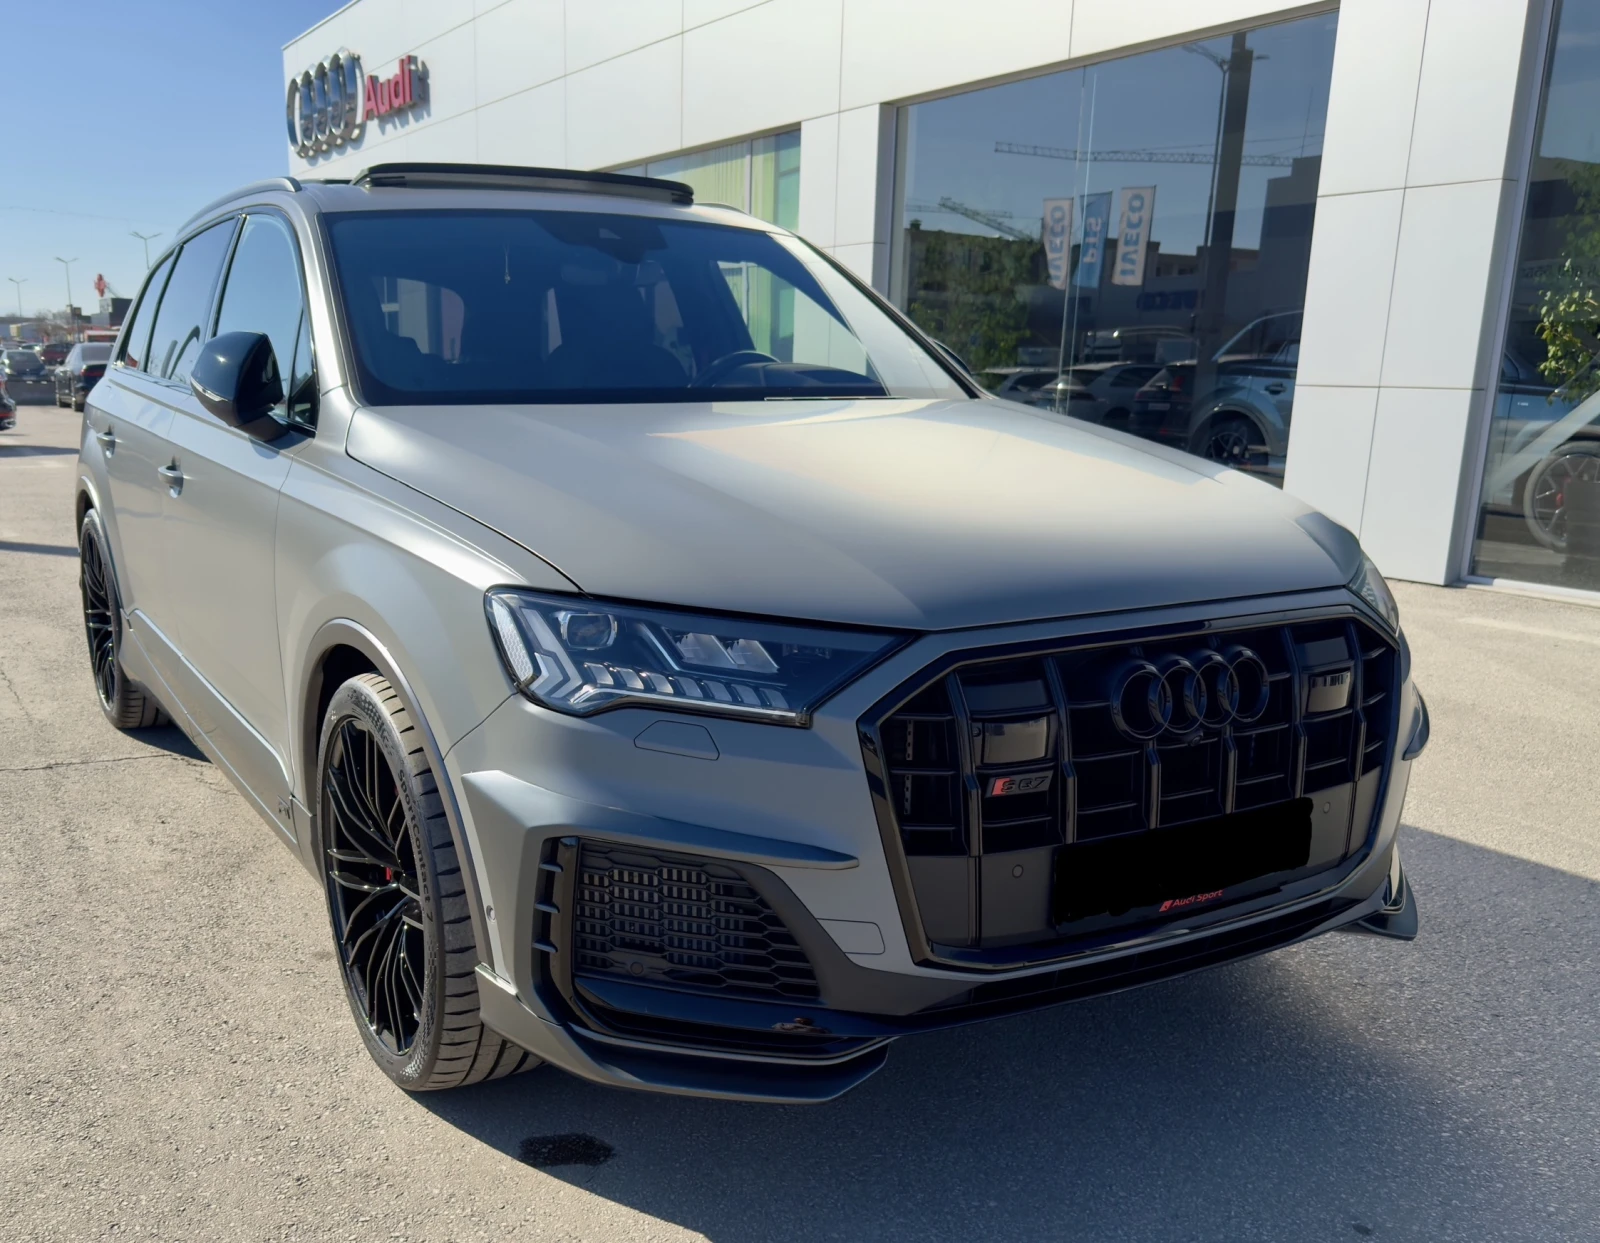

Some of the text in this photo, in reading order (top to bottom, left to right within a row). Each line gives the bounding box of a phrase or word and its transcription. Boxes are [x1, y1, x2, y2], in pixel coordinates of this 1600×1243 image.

[363, 55, 412, 122] Audi
[397, 769, 431, 903] SportContact
[1172, 889, 1224, 907] Audi Sport
